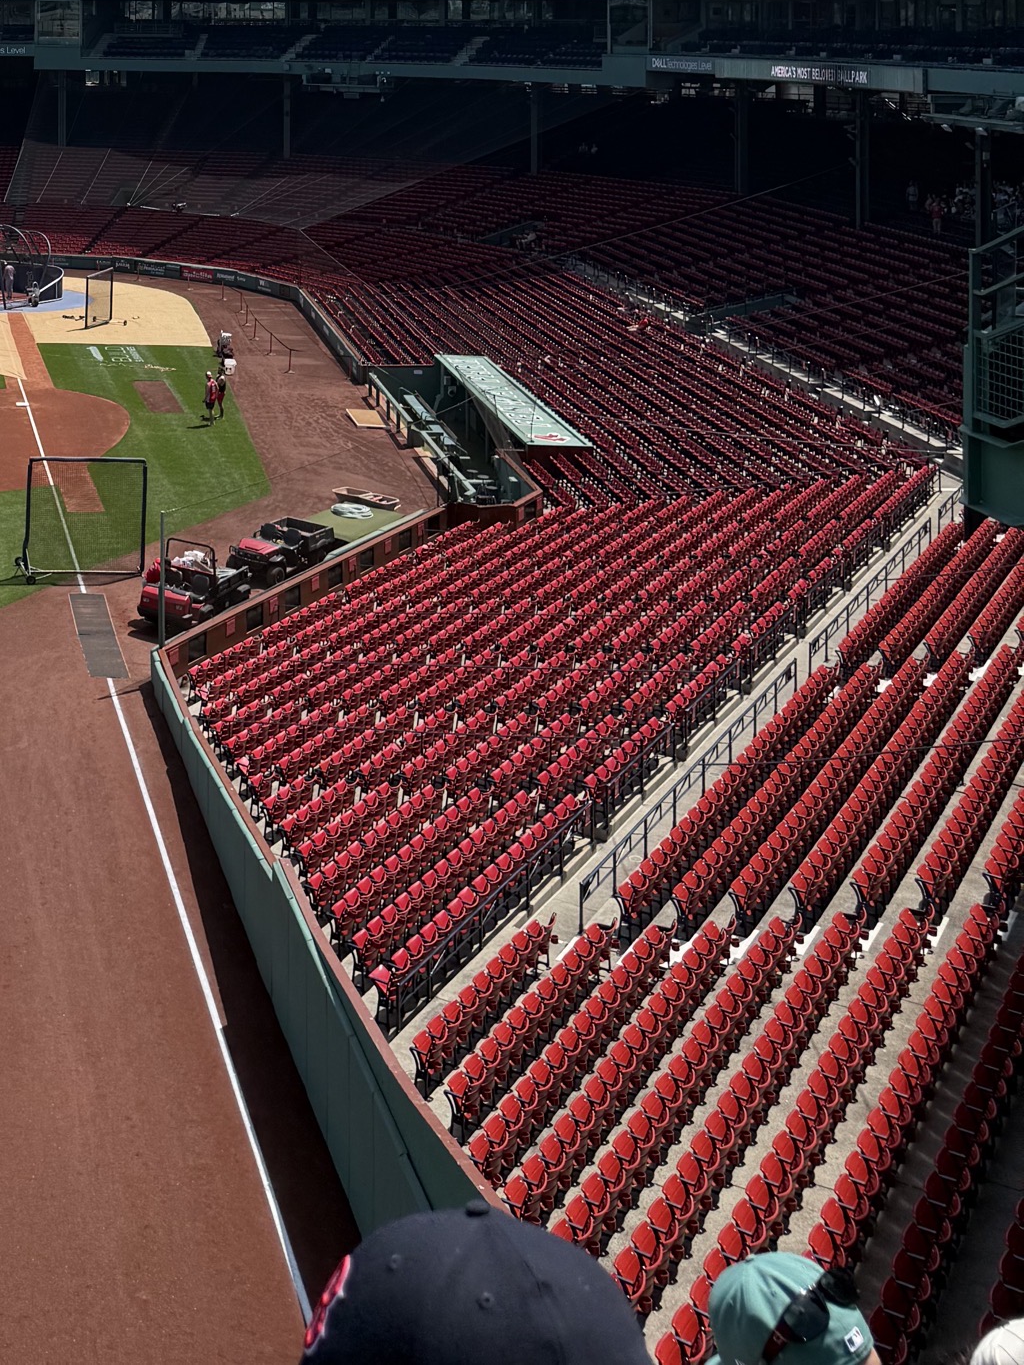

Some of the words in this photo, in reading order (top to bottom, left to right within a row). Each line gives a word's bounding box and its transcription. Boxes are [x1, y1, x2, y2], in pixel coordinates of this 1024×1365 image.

[6, 46, 26, 54] Level
[698, 62, 712, 70] Level
[771, 65, 796, 77] AMERICA'S
